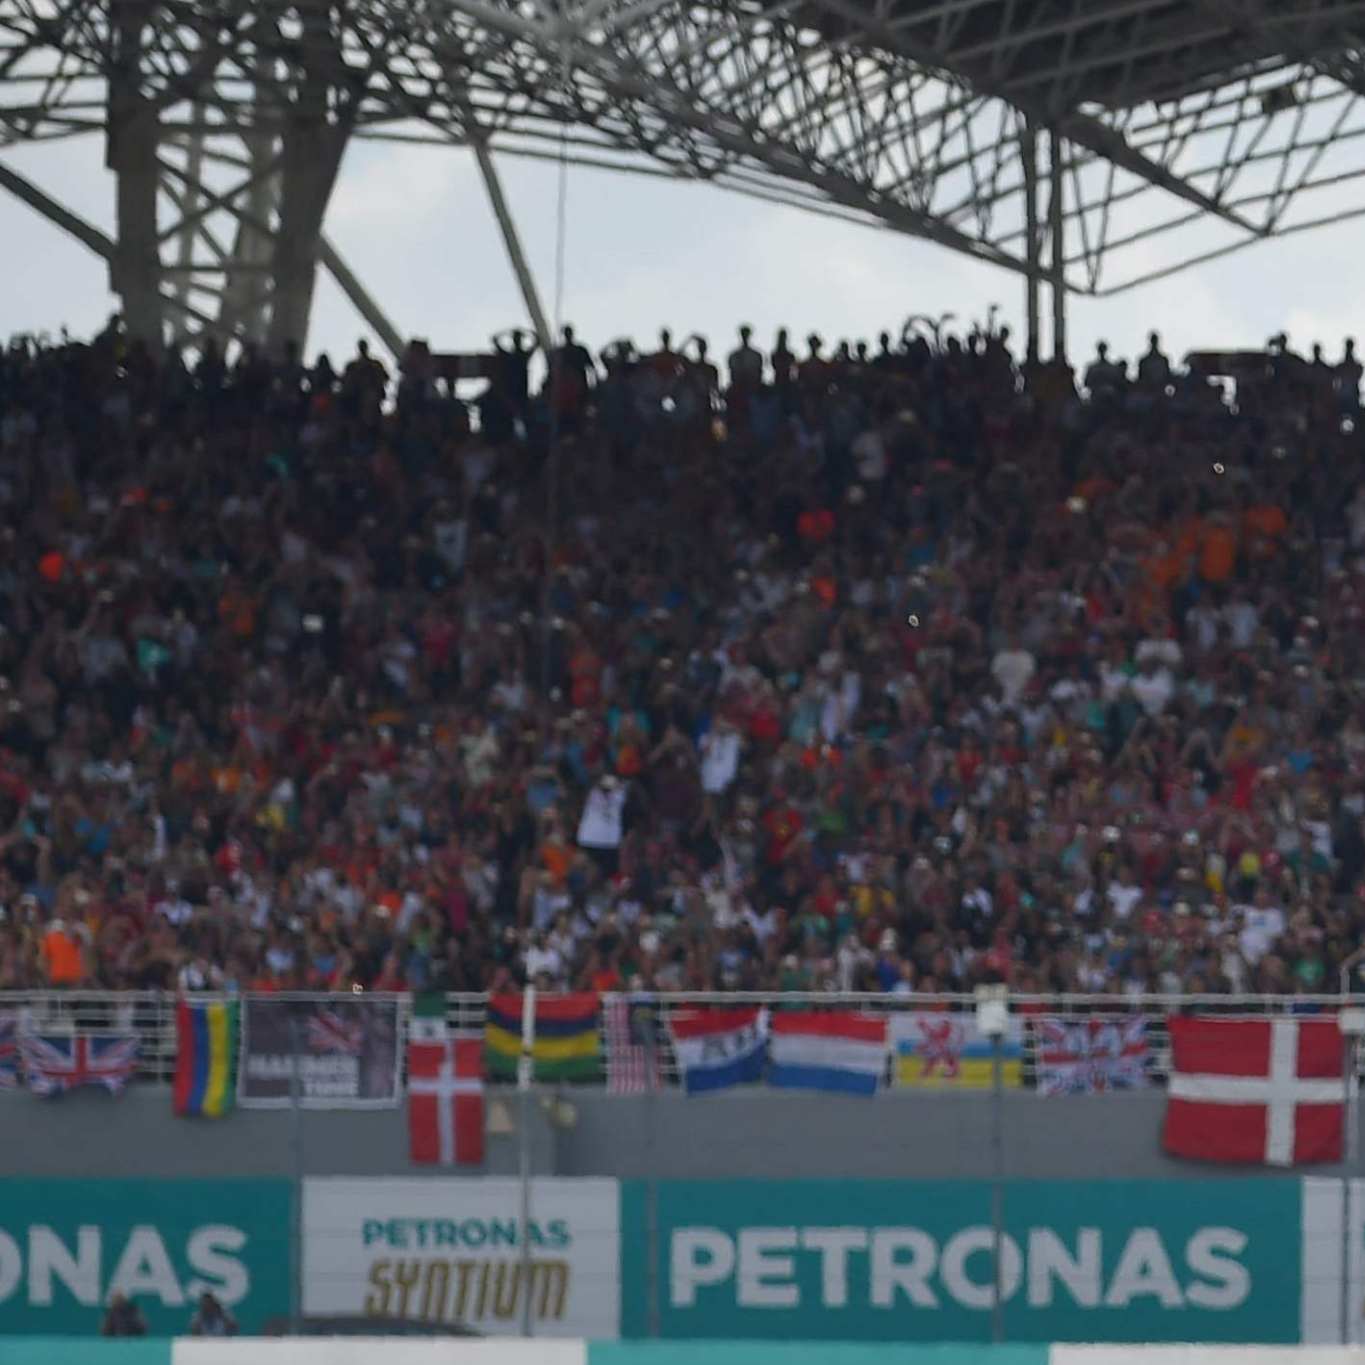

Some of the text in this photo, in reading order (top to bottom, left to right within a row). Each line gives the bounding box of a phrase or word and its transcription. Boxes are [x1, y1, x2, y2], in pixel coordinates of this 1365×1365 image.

[0, 1223, 249, 1308] NAS
[362, 1217, 573, 1247] PETRONAS
[671, 1226, 1252, 1310] PETRONAS
[364, 1258, 570, 1322] SYNTIUM
